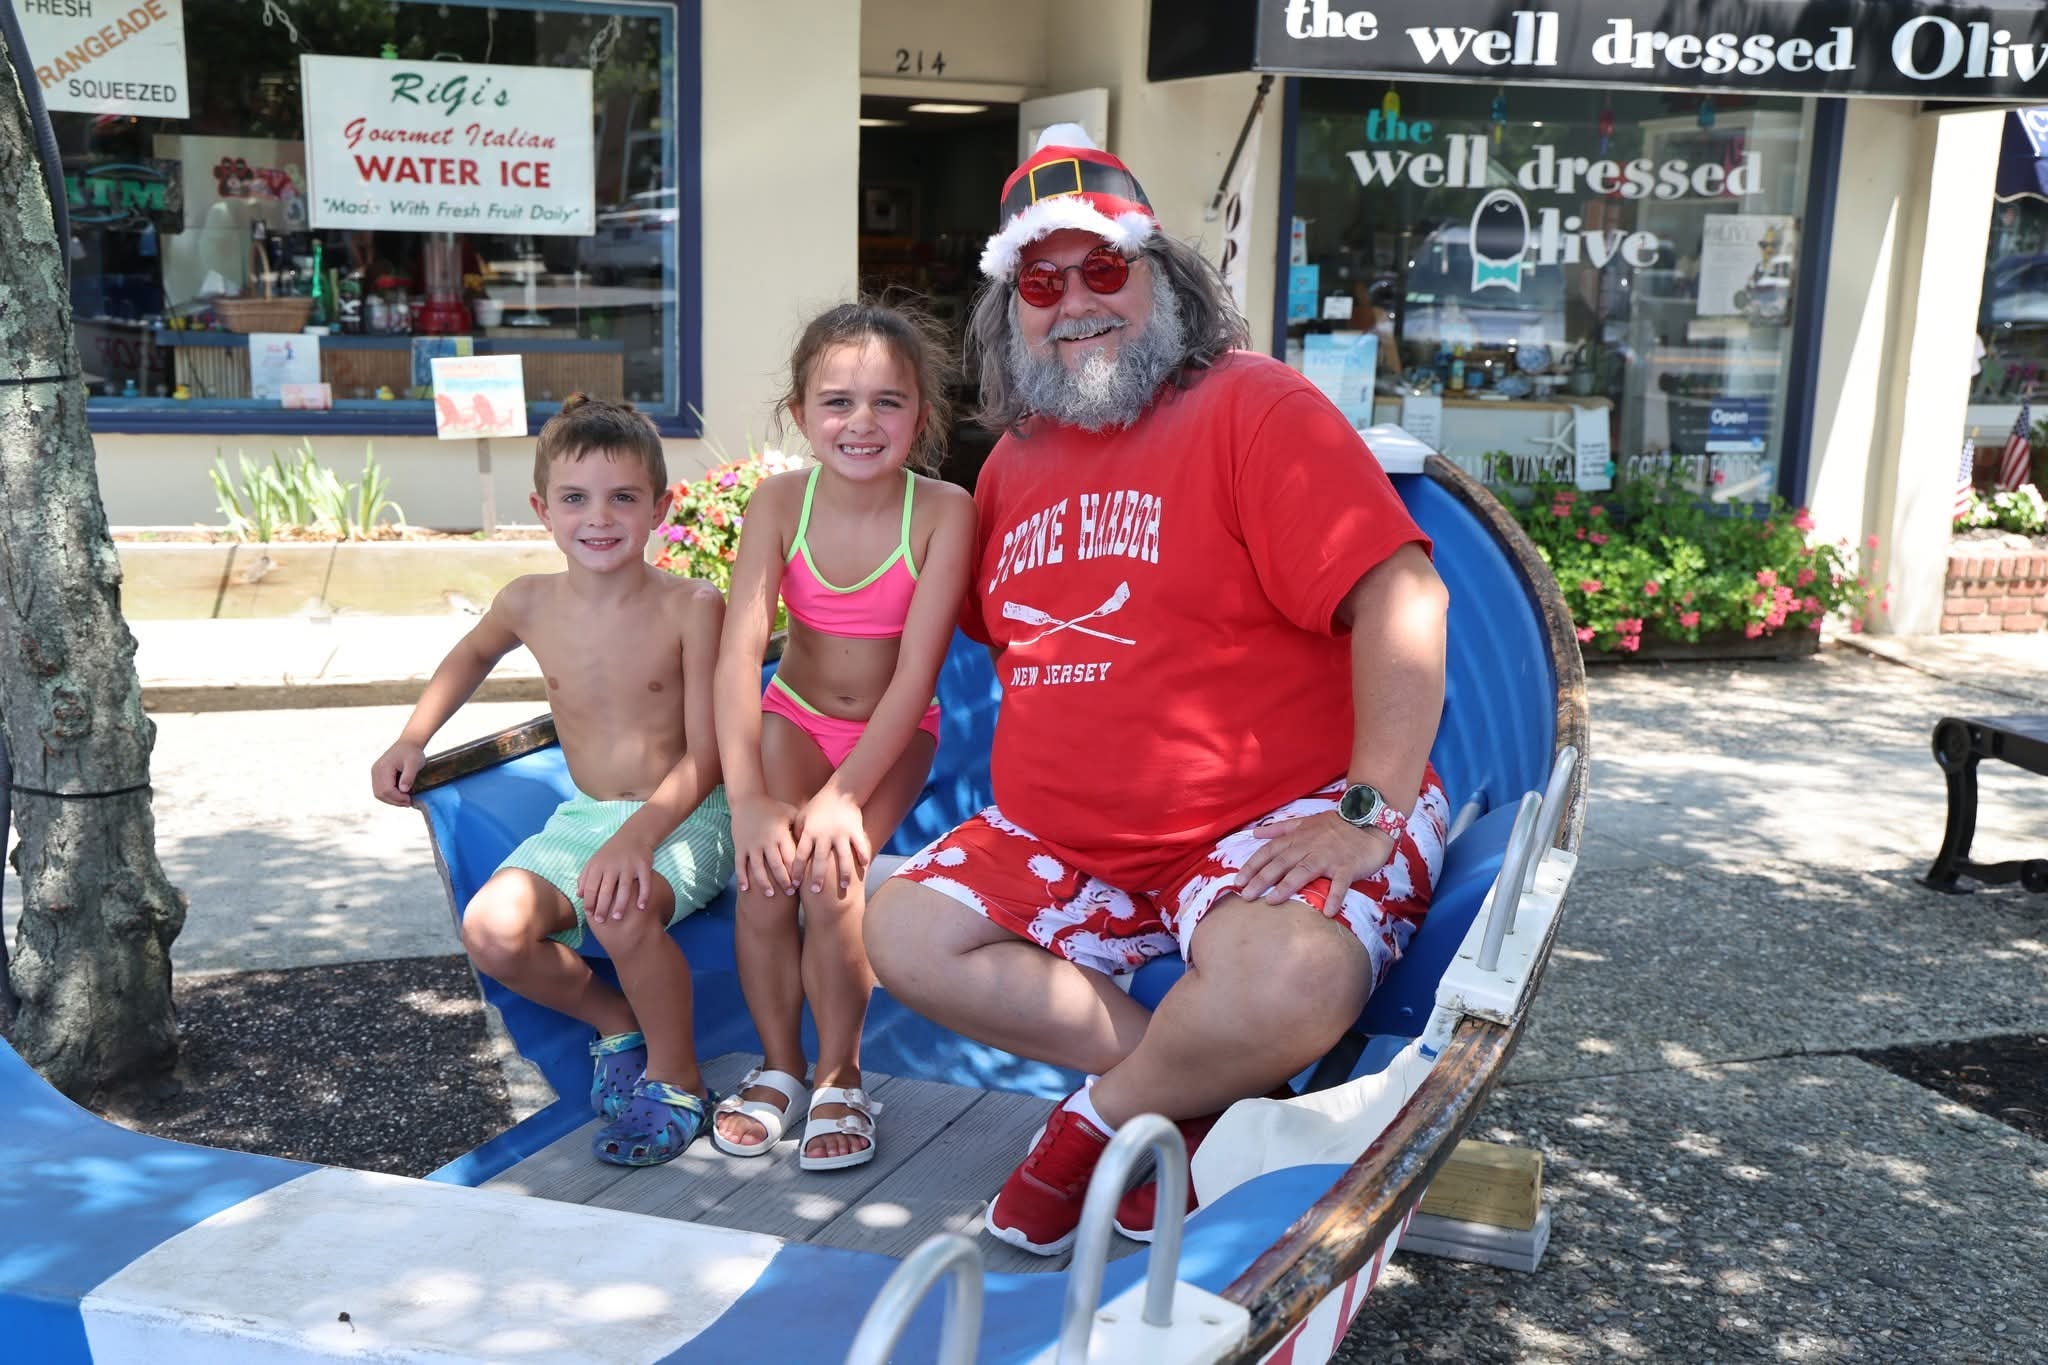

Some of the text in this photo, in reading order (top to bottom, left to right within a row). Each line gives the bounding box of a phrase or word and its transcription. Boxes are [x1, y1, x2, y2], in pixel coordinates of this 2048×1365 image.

[24, 0, 92, 17] FRESH
[36, 0, 168, 89] RANGEADE
[1284, 0, 2048, 83] the well dressed Oliv
[895, 49, 947, 76] 214
[69, 79, 177, 103] SQUEEZED
[344, 117, 556, 149] Gourmet Italian
[1366, 107, 1433, 144] the
[354, 155, 551, 189] WATER ICE
[1345, 134, 1766, 199] well dressed
[390, 199, 431, 217] With
[436, 201, 481, 219] Fresh
[487, 202, 524, 220] Fruit
[1711, 407, 1749, 427] Open
[988, 490, 1162, 595] STONE HARBOR
[1010, 662, 1112, 687] NEW JERSEY
